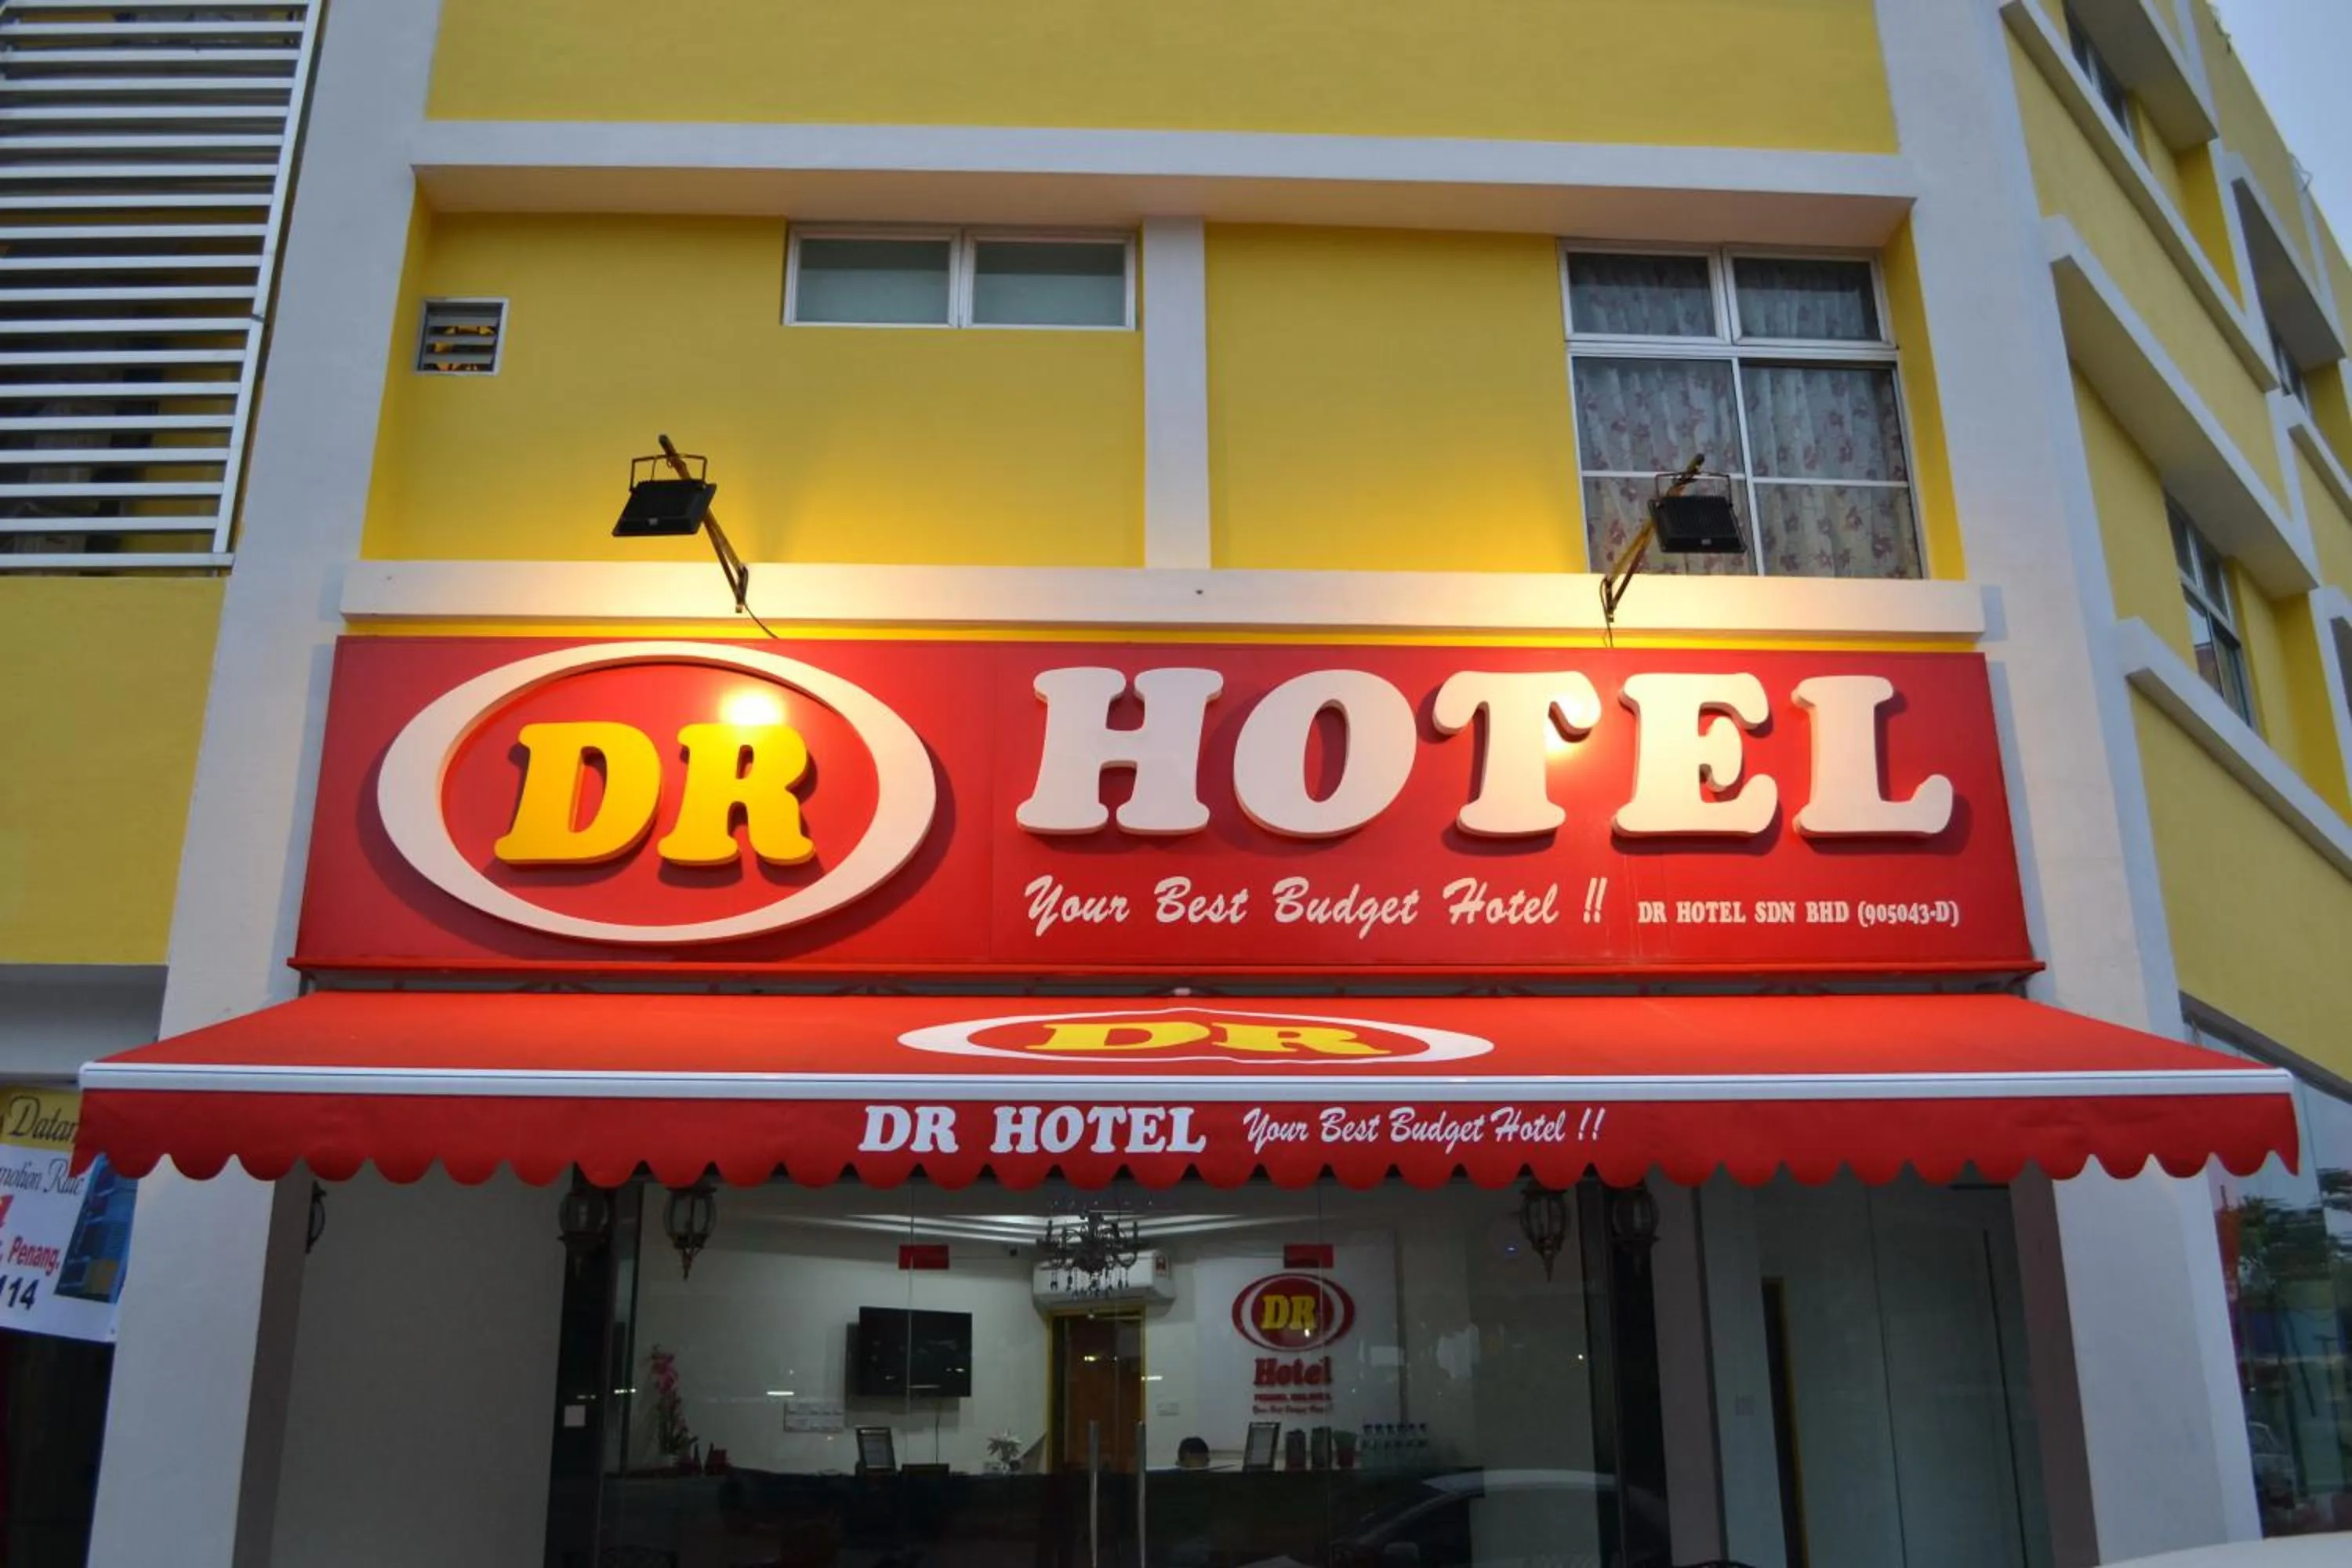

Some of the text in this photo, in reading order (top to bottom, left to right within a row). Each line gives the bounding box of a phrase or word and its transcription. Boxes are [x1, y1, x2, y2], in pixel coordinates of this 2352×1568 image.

[1016, 666, 1953, 838] HOTEL
[494, 721, 815, 866] DR
[1024, 874, 1130, 936] Your
[1154, 876, 1249, 924] Best
[1272, 876, 1420, 939] Budget
[1443, 877, 1559, 925] Hotel
[1638, 901, 1960, 927] DR HOTEL SDN BHD (905043-D)
[1025, 1021, 1392, 1055] DR
[858, 1105, 1207, 1154] DR HOTEL
[1243, 1107, 1309, 1154] Your
[1319, 1106, 1381, 1142] Best
[1389, 1106, 1486, 1154] Budget
[1490, 1106, 1566, 1142] Hotel
[1261, 1294, 1316, 1330] DR
[1253, 1356, 1332, 1386] Hotel
